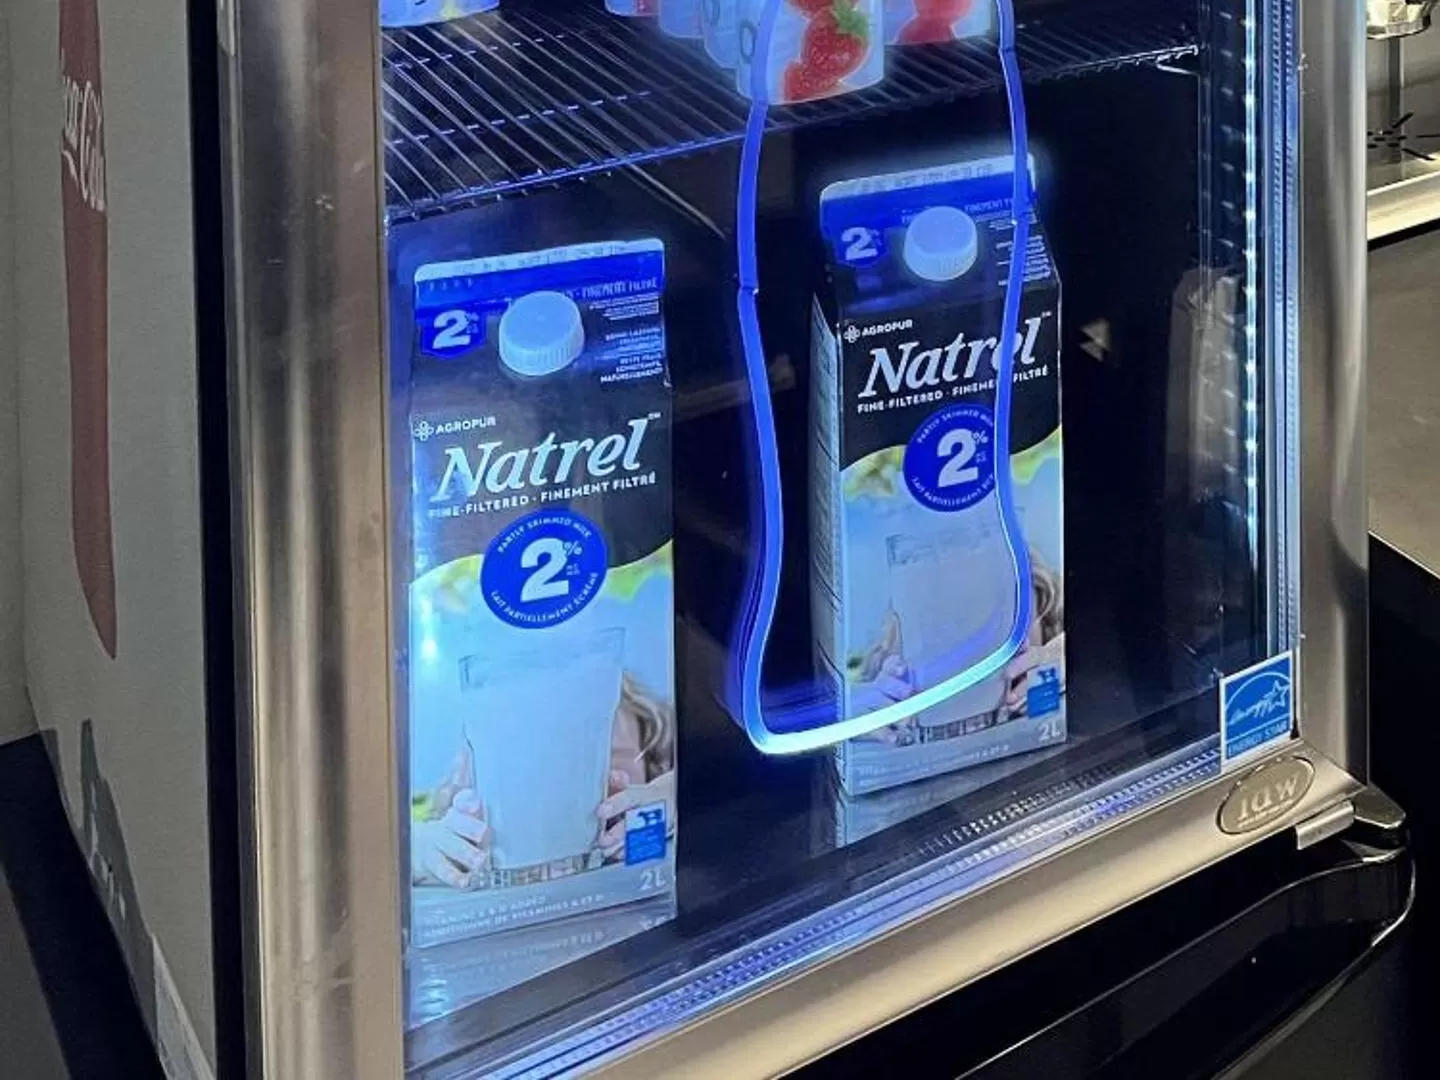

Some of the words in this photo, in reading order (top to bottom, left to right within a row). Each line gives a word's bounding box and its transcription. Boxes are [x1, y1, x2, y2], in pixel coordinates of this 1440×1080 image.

[862, 319, 913, 338] AGROPUR
[857, 390, 944, 415] FINE-FILTERED
[952, 381, 996, 397] FINEME
[435, 416, 497, 435] AGROPUR
[430, 417, 650, 503] Natrel
[428, 494, 530, 519] FINE-FILTERED
[540, 481, 611, 503] FINEMENT
[612, 470, 656, 491] FILTRÉ
